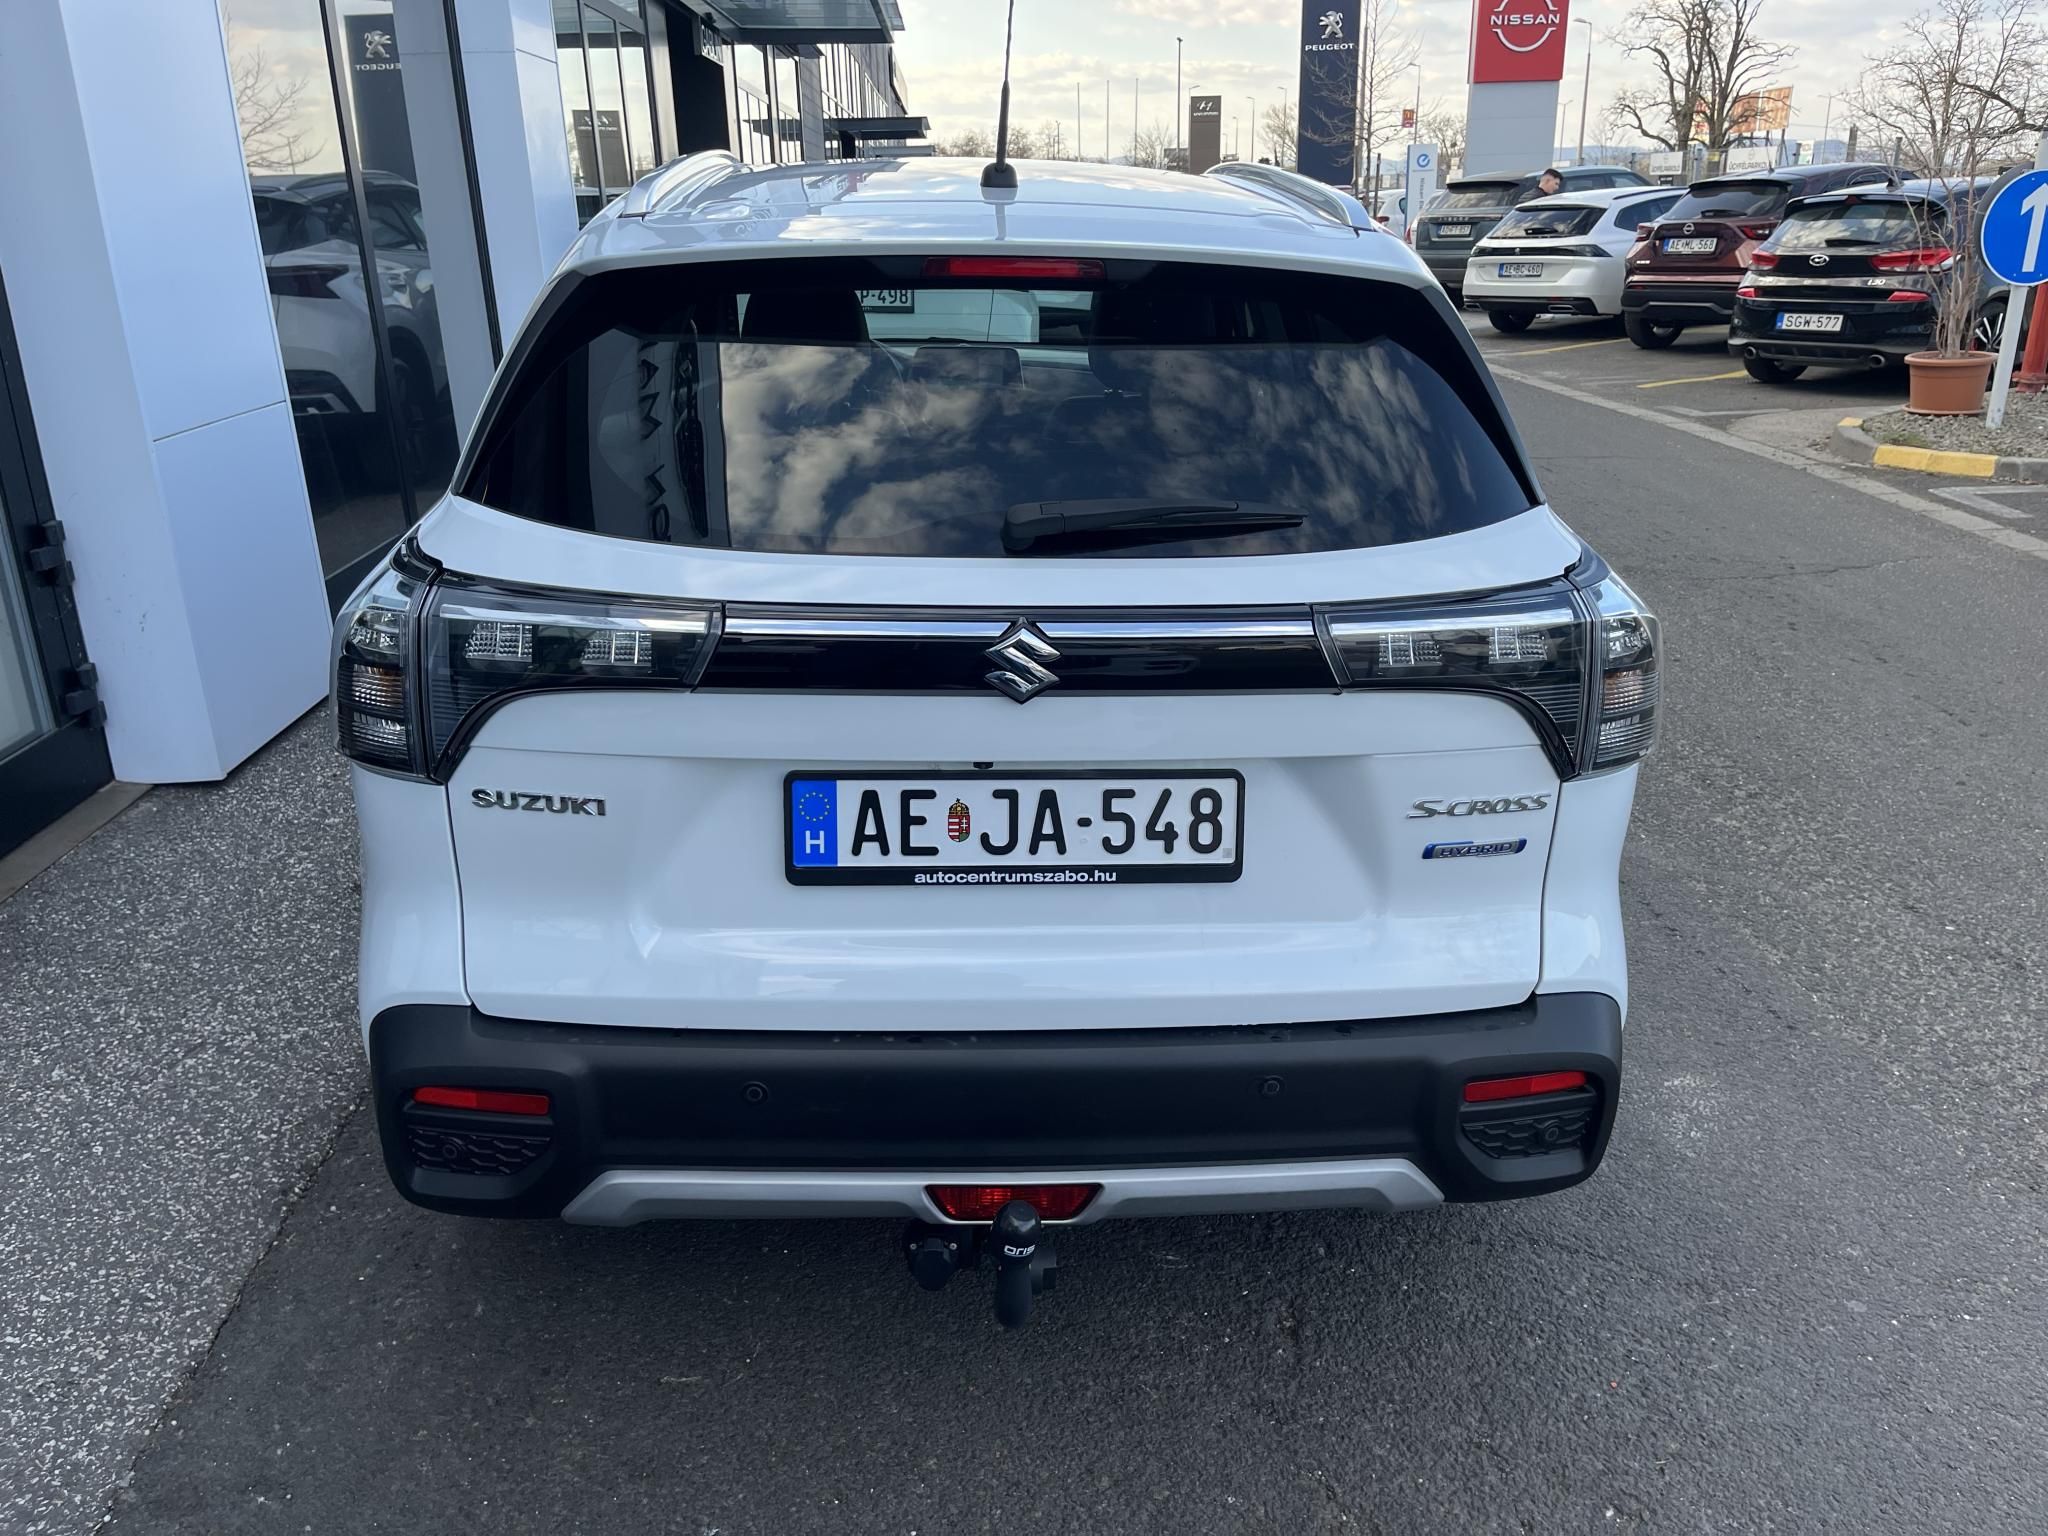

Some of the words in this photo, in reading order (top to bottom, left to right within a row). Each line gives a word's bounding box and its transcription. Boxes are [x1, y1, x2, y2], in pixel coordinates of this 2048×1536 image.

[1490, 14, 1560, 25] NISSAN
[1305, 43, 1355, 51] PEUGEOT
[1785, 315, 1840, 329] SGW-577
[472, 788, 606, 816] SUZUKI
[1406, 793, 1551, 818] S-CROSS
[852, 789, 939, 856] AE
[805, 829, 825, 853] H
[1439, 842, 1512, 857] HYBRID
[914, 869, 1117, 883] autocentrumszabo.hu
